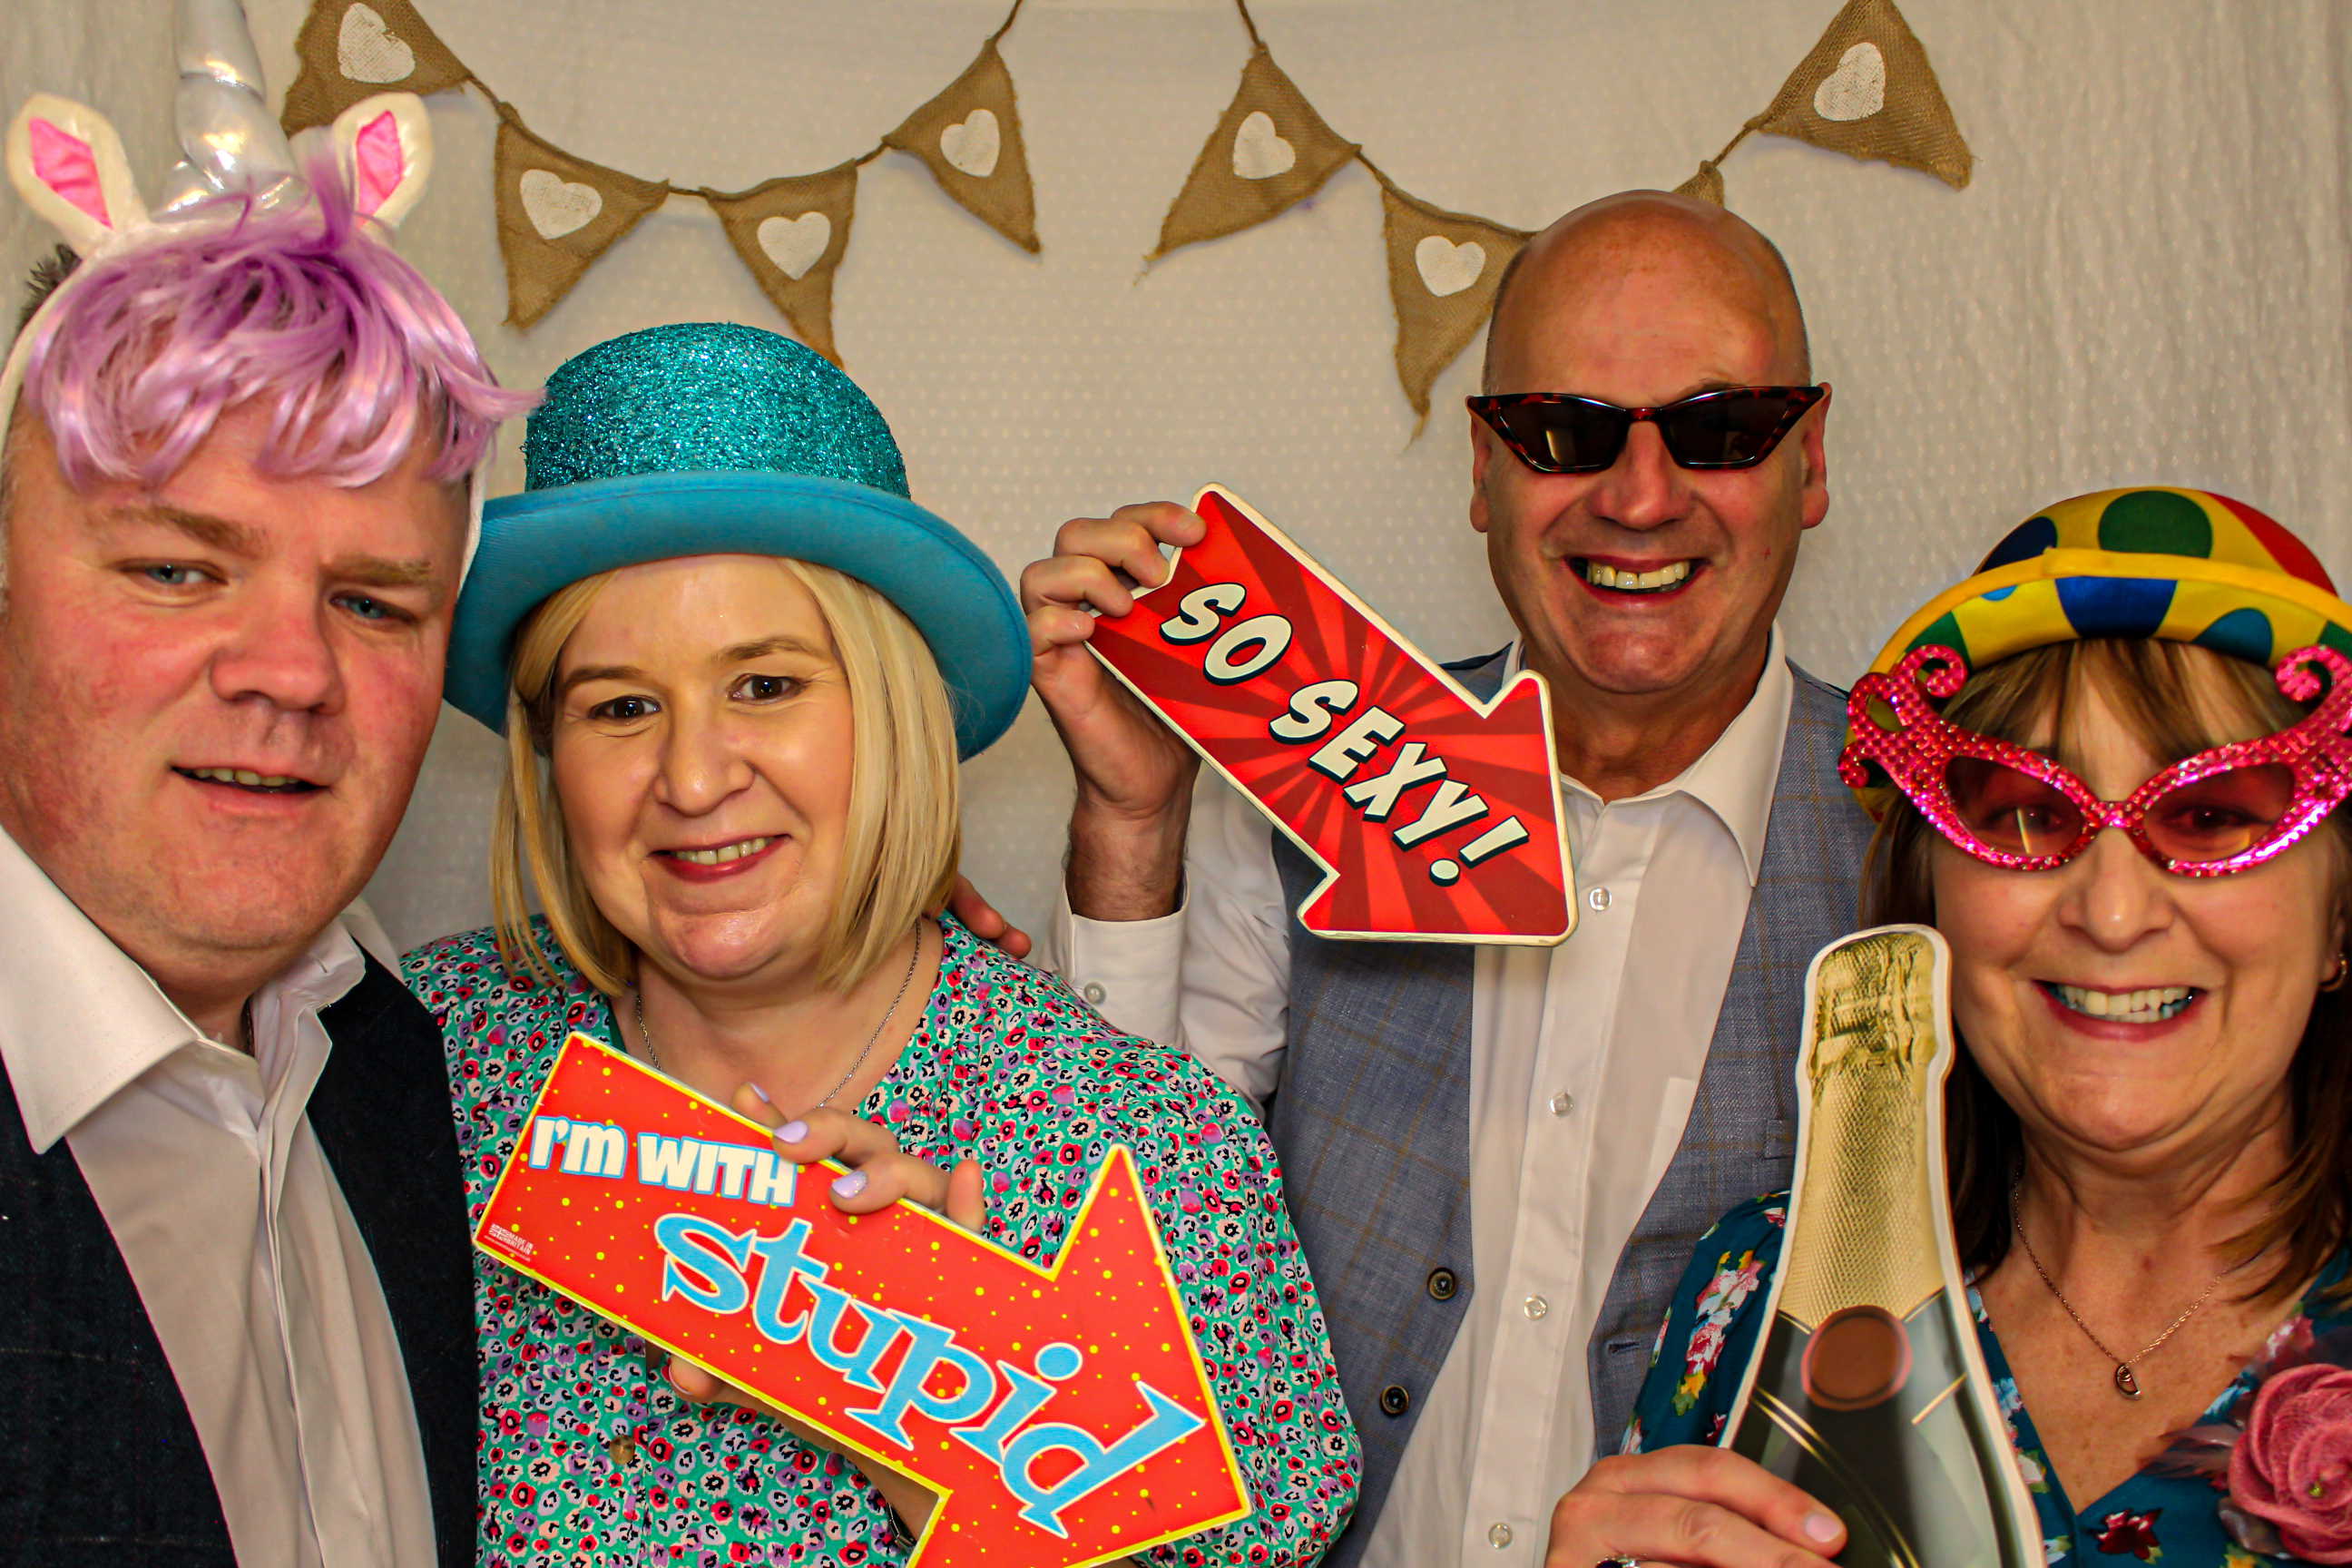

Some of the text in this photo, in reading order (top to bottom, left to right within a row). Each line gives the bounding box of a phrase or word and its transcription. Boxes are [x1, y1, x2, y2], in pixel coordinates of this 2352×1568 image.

[1161, 583, 1529, 886] SO SEXY!
[637, 1133, 798, 1208] WITH
[505, 1238, 532, 1255] BRITAIN
[508, 1233, 534, 1250] MADE IN
[653, 1214, 1204, 1539] stupid
